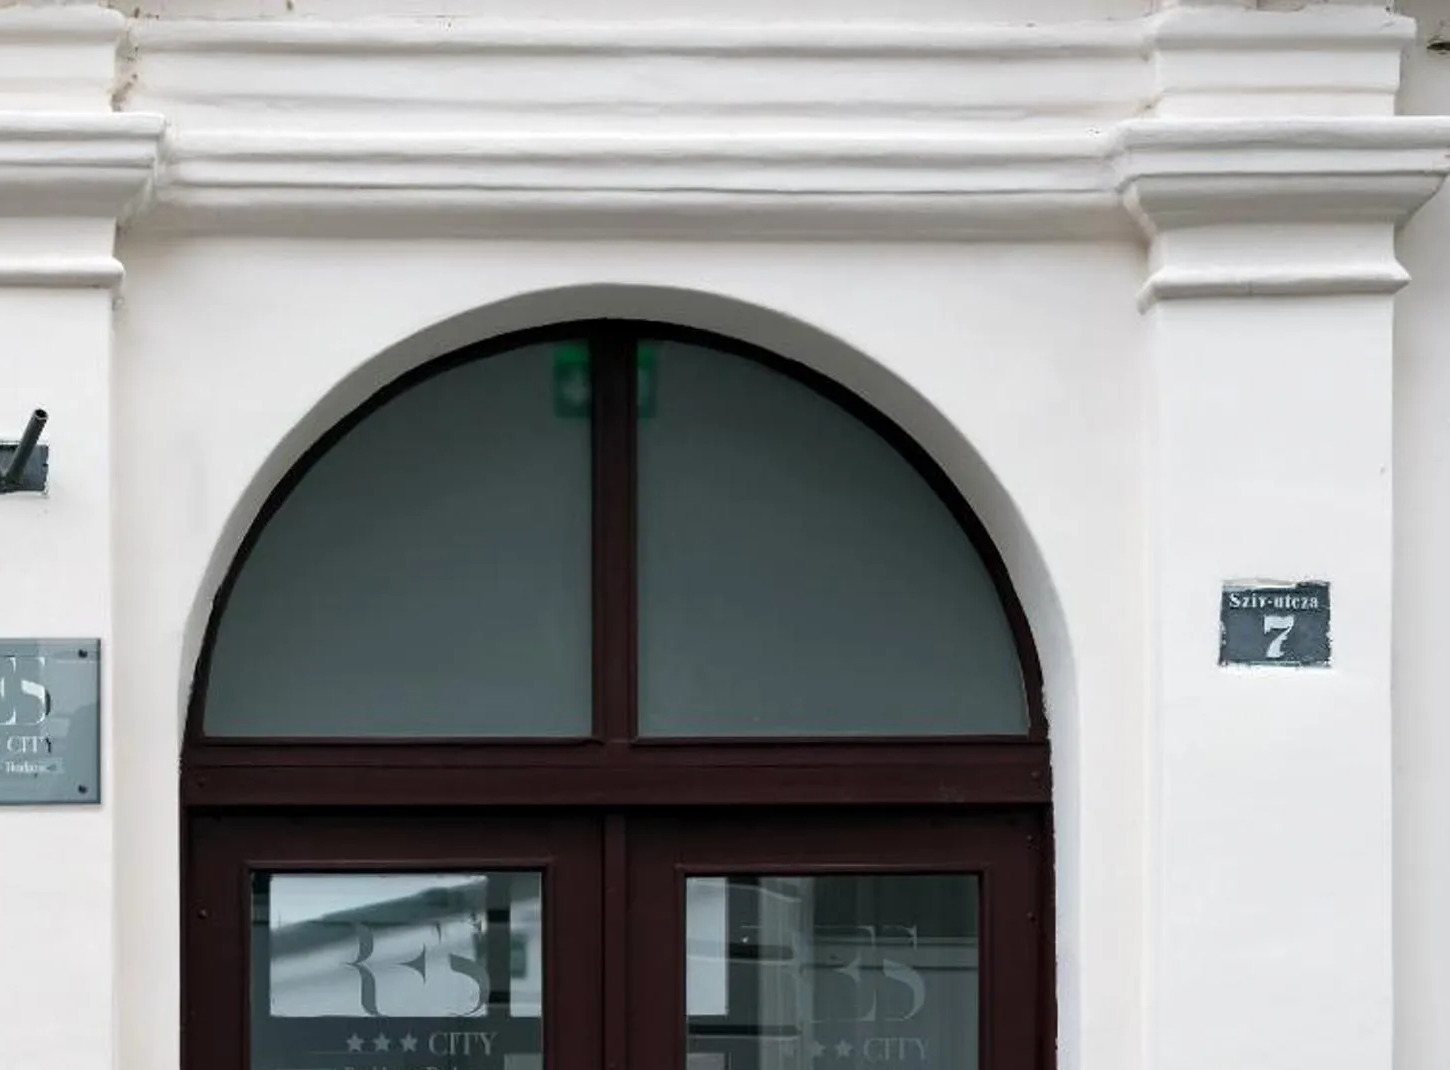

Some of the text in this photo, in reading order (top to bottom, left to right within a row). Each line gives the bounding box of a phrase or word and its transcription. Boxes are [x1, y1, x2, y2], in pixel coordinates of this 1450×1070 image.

[1263, 614, 1294, 658] 7
[6, 735, 52, 754] CITY
[4, 759, 62, 779] Budap
[427, 1031, 498, 1056] CITY
[862, 1036, 929, 1061] CITY
